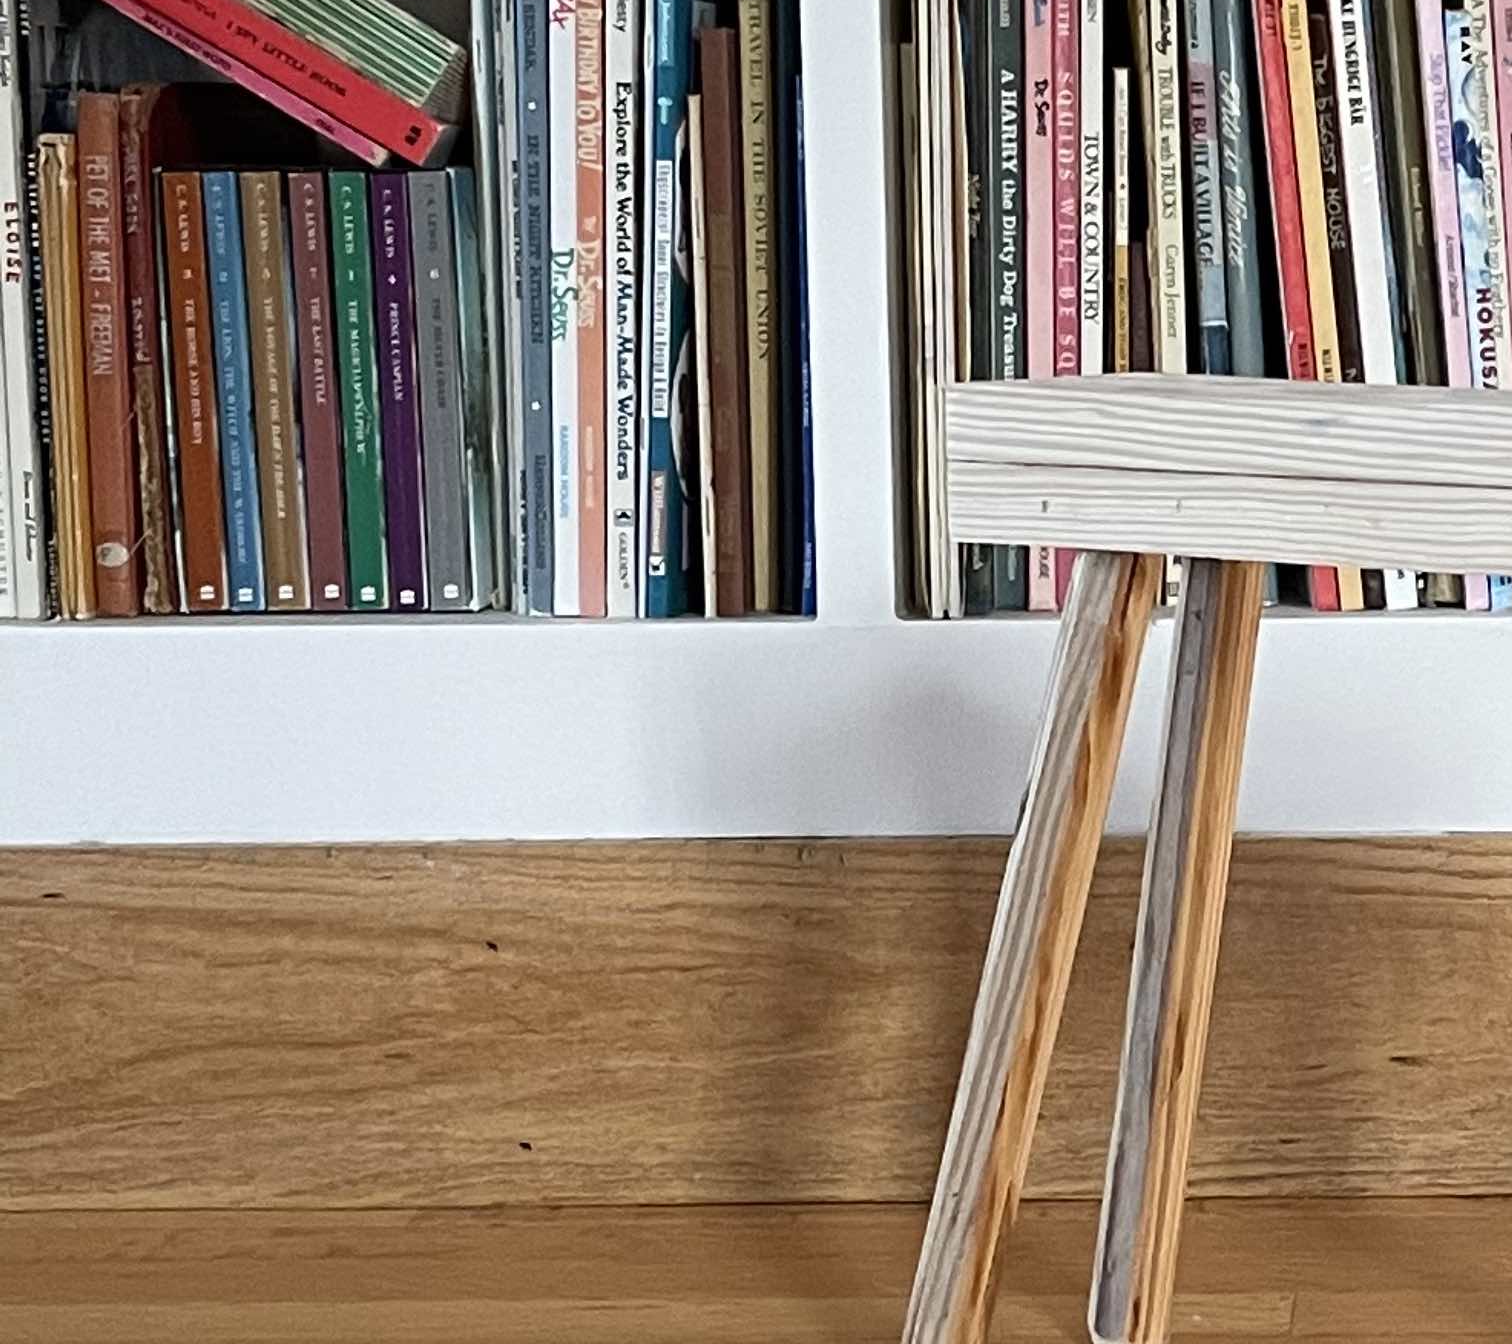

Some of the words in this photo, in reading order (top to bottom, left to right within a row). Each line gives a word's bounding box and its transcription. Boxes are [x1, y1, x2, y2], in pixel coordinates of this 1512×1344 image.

[577, 7, 603, 92] BIRTHDAY
[747, 1, 763, 86] TRAVEL
[1471, 15, 1487, 44] The
[1000, 69, 1014, 82] A
[1339, 20, 1358, 74] HUNGRIGE
[1349, 97, 1367, 124] BÄR
[1475, 48, 1493, 127] Adventures
[614, 82, 631, 156] Explore
[751, 100, 765, 124] IN
[1159, 68, 1174, 129] TROUBLE
[527, 135, 540, 155] IN
[1001, 89, 1017, 173] HARRY
[1056, 71, 1075, 180] SQUIDS
[1161, 136, 1176, 160] with
[1191, 117, 1210, 171] BUILT
[1481, 131, 1496, 148] of
[86, 156, 109, 180] PET
[752, 138, 766, 183] THE
[1084, 133, 1100, 196] TOWN
[1313, 54, 1330, 83] The
[1326, 188, 1346, 248] HOUSE
[88, 188, 110, 208] OF
[527, 160, 541, 197] THE
[615, 162, 631, 192] the
[1001, 179, 1017, 208] the
[1161, 165, 1176, 219] TRUCKS
[1193, 174, 1210, 187] A
[5, 202, 20, 283] ELOISE
[88, 217, 111, 244] THE
[343, 215, 355, 254] LEWIS
[384, 219, 395, 258] LEWIS
[615, 197, 632, 253] World
[753, 193, 768, 272] SOVIET
[998, 215, 1017, 265] Dirty
[1058, 198, 1075, 268] WILL
[1224, 185, 1247, 267] Venice
[1487, 217, 1502, 240] with
[88, 251, 112, 282] MET
[550, 248, 575, 281] Dr.
[577, 240, 599, 272] Dr.
[617, 257, 633, 277] of
[1084, 222, 1100, 325] COUNTRY
[348, 301, 359, 322] THE
[577, 274, 601, 328] Seuss
[1000, 270, 1017, 306] Dog
[1058, 286, 1075, 320] BE
[552, 286, 578, 341] Seuss
[616, 281, 633, 390] Man-Made
[756, 290, 770, 361] UNION
[90, 304, 113, 375] FREEMAN
[314, 358, 326, 404] BATTLE
[616, 395, 633, 480] Wonders
